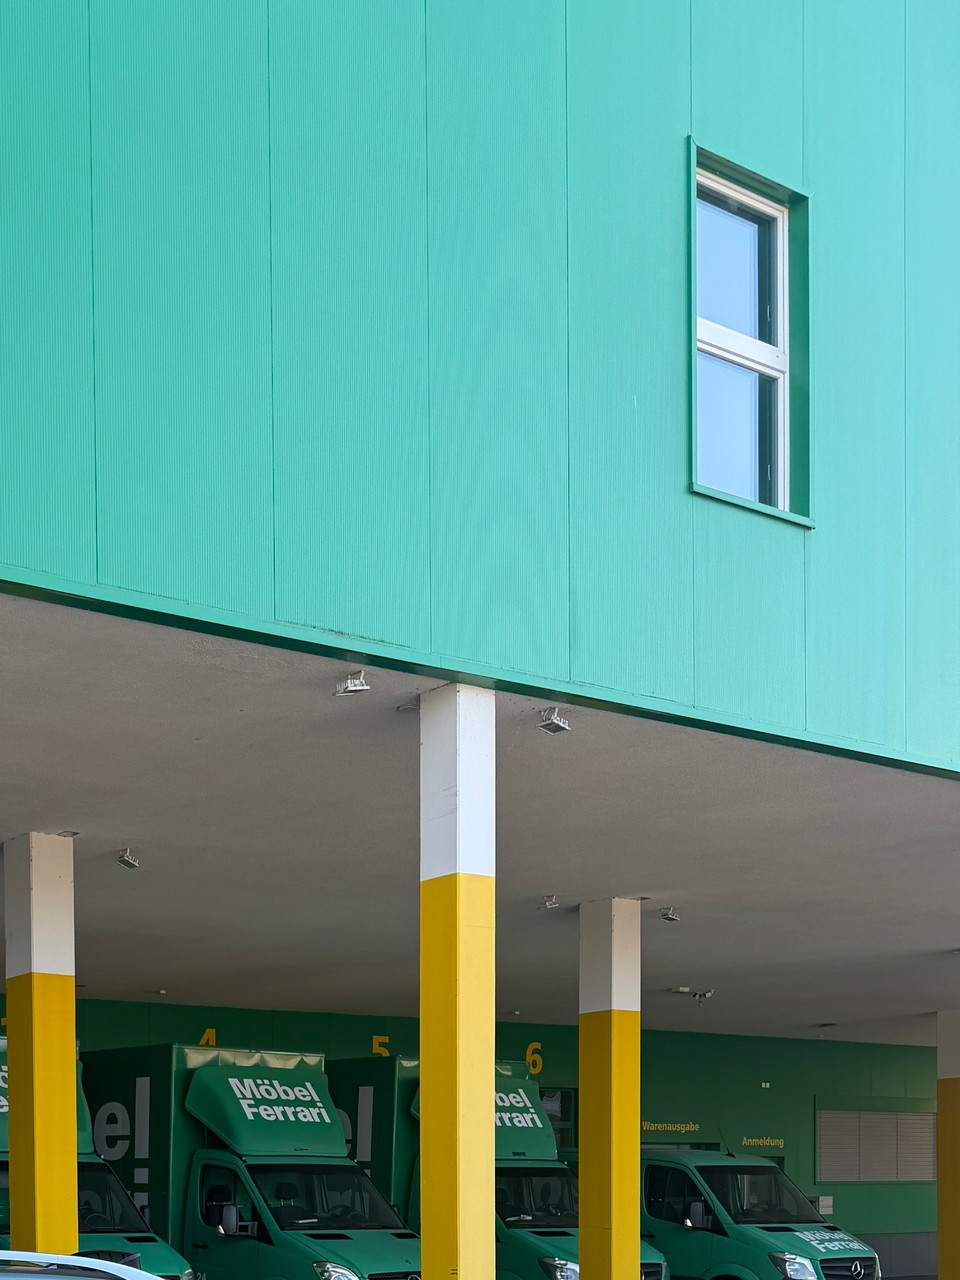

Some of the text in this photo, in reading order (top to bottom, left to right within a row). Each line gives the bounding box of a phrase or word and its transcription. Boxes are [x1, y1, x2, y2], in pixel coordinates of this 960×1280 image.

[372, 1036, 390, 1057] 5
[526, 1042, 543, 1075] 6
[228, 1078, 321, 1102] Möbel
[495, 1088, 533, 1108] bel
[238, 1099, 331, 1123] Ferrari
[495, 1108, 543, 1128] rrari
[642, 1121, 700, 1133] Warenausgabe
[742, 1137, 784, 1148] Anmeldung
[794, 1230, 854, 1242] Möbel
[810, 1240, 869, 1252] Ferrari
